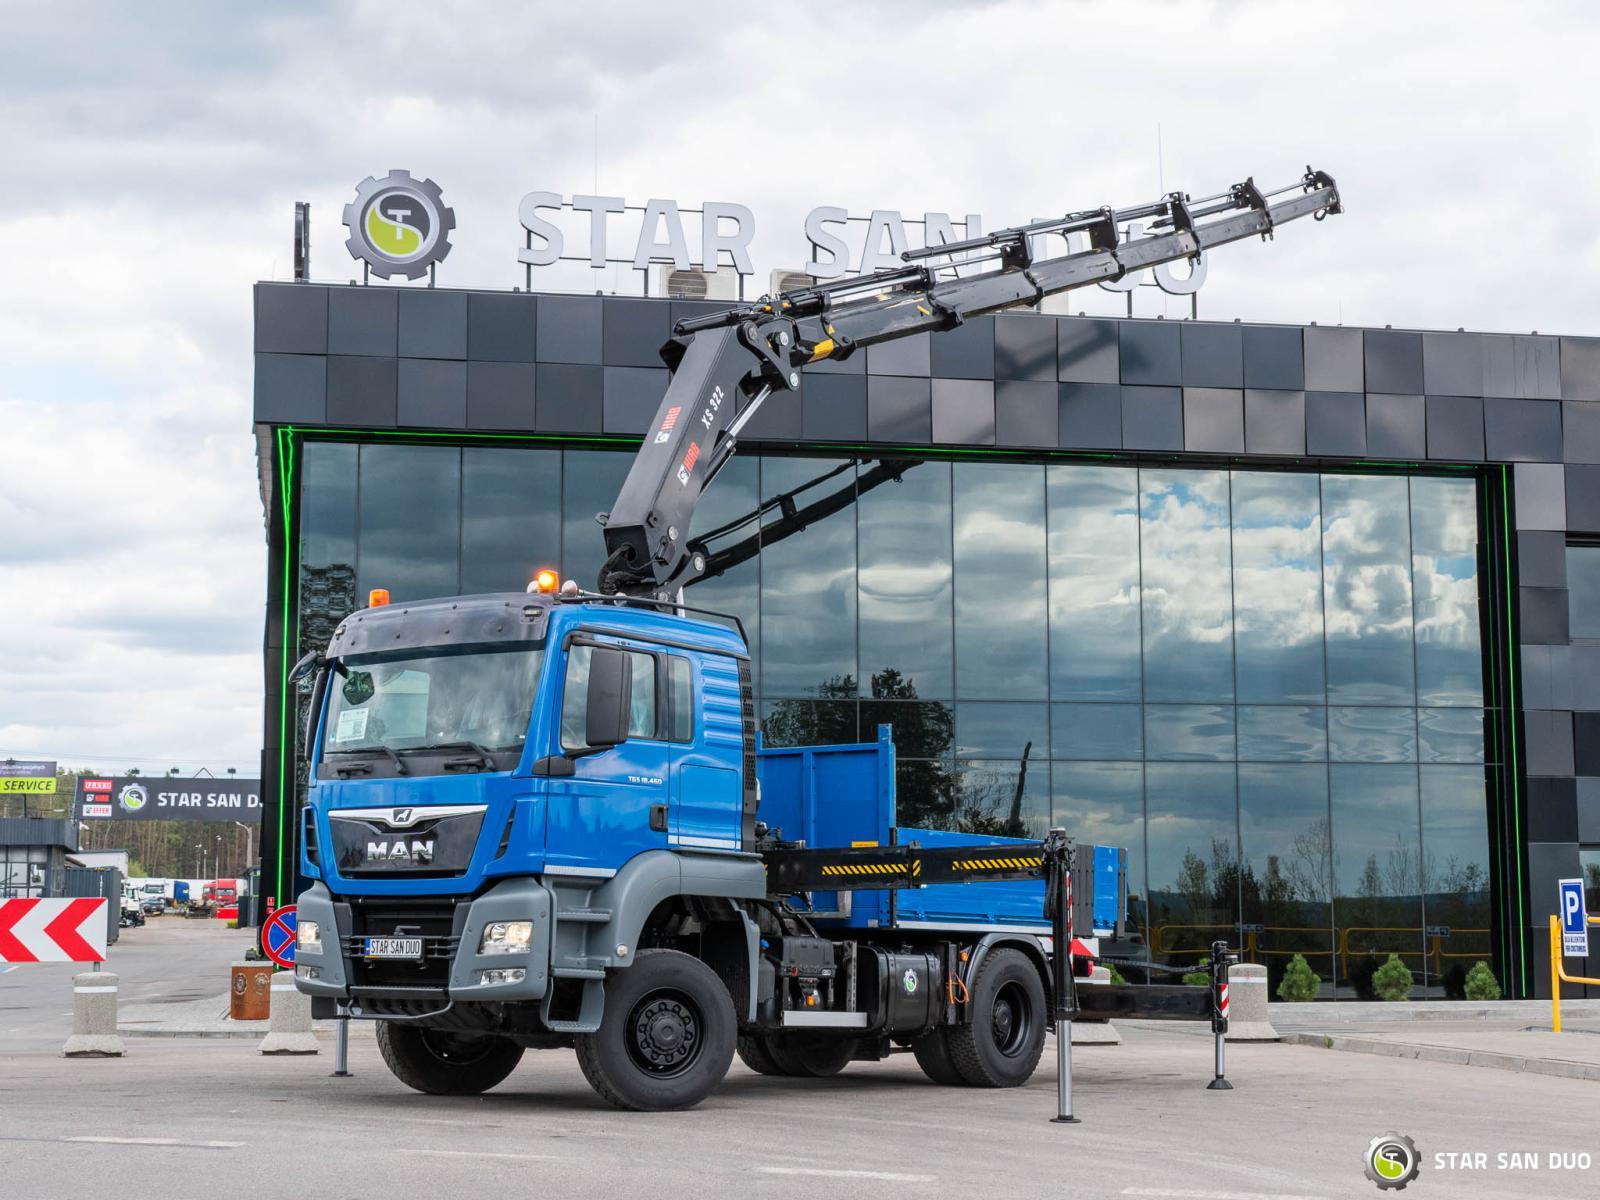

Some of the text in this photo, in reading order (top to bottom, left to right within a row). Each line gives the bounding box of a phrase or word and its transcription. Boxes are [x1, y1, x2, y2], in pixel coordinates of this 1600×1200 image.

[517, 191, 756, 275] STAR
[805, 206, 982, 281] SAN
[660, 406, 682, 432] HIAB
[701, 385, 724, 430] XS 322
[682, 441, 700, 472] HIAB
[4, 780, 52, 791] SERVICE
[157, 792, 264, 808] STAR SAN D
[367, 840, 434, 861] MAN
[1565, 891, 1579, 925] P
[371, 940, 420, 954] STAR SAN DUO
